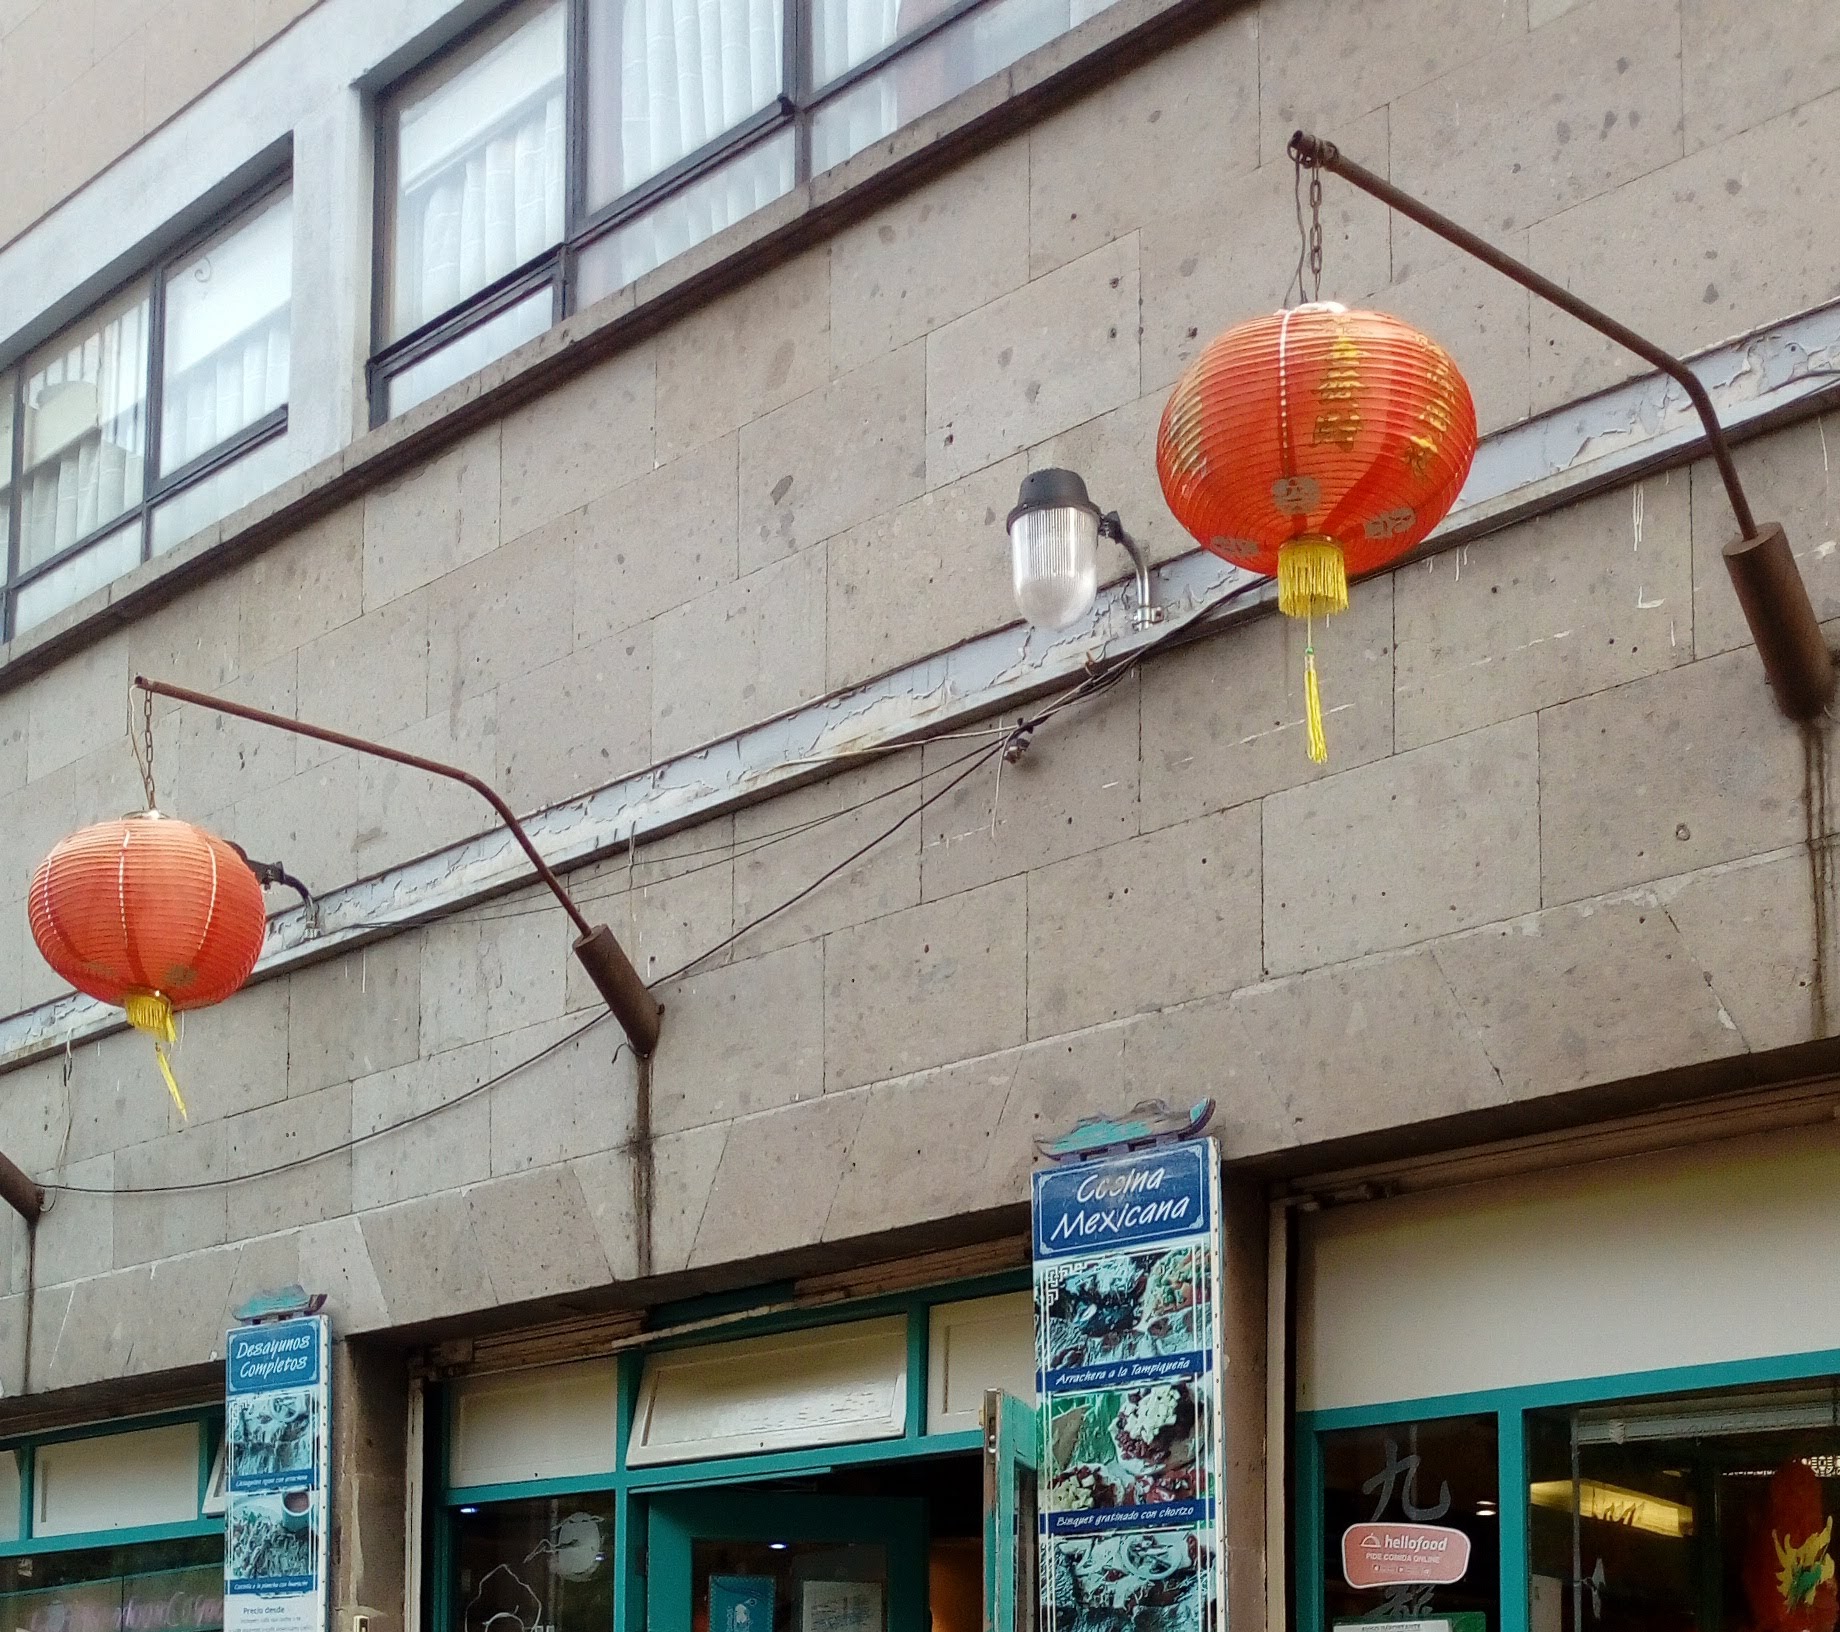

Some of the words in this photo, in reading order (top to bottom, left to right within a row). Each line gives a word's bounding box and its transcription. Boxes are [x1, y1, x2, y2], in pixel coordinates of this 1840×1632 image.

[1050, 1195, 1191, 1241] Mexicana
[236, 1335, 311, 1359] Desayunos
[240, 1355, 308, 1379] Completos
[1055, 1367, 1107, 1386] Arrachera
[1108, 1370, 1116, 1379] a
[1117, 1366, 1129, 1378] la
[1131, 1357, 1191, 1377] Tampiqueña
[1095, 1510, 1139, 1525] gratinado
[1140, 1510, 1158, 1520] con
[1158, 1506, 1194, 1518] chorizo
[1384, 1534, 1448, 1552] hellofood
[1365, 1552, 1382, 1560] PIDE
[1383, 1553, 1412, 1562] COMIDA
[1413, 1555, 1441, 1564] ONLINE
[243, 1607, 264, 1615] Precio
[264, 1606, 285, 1614] desde
